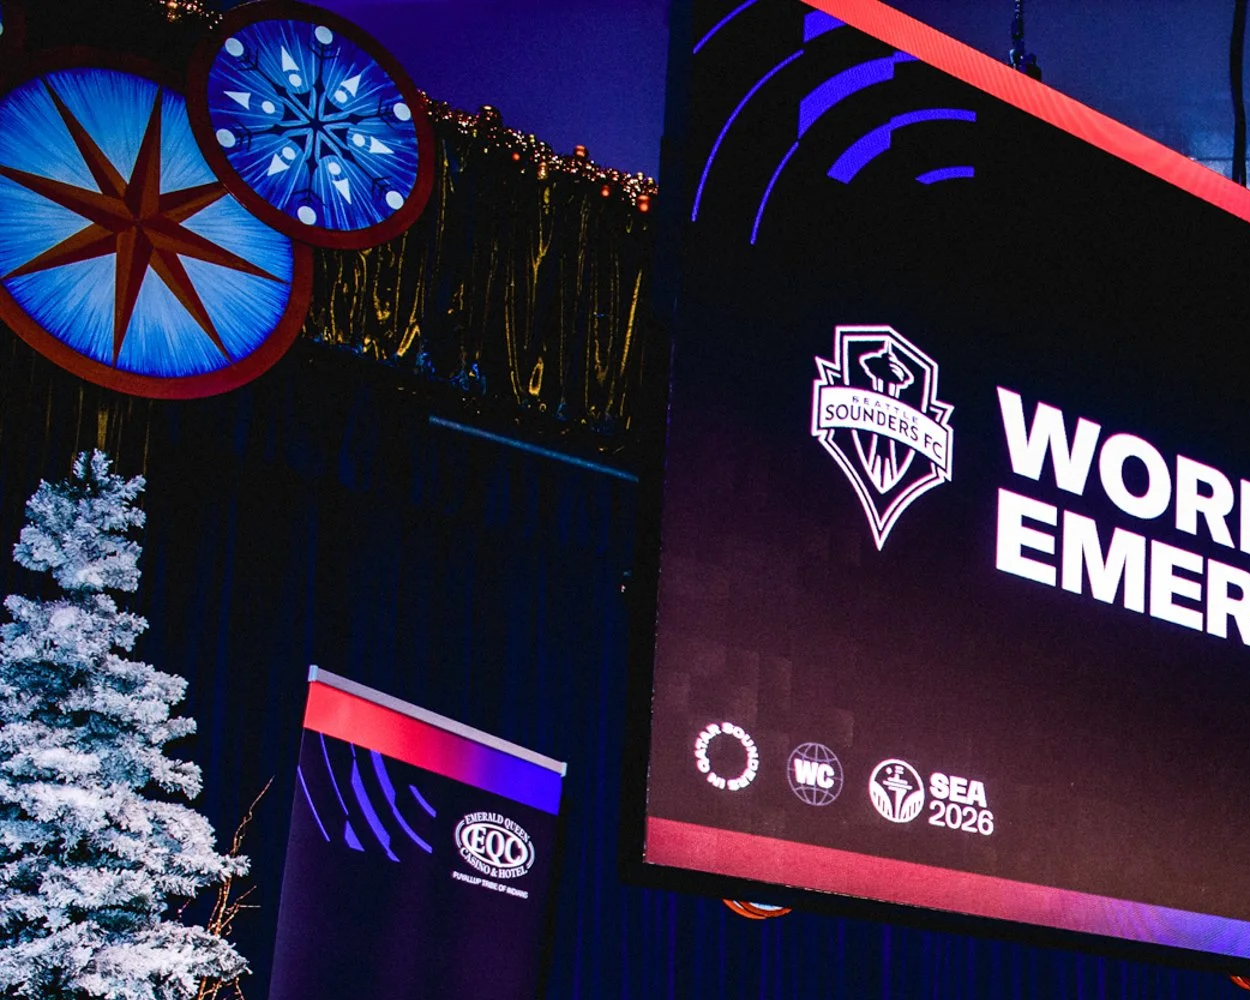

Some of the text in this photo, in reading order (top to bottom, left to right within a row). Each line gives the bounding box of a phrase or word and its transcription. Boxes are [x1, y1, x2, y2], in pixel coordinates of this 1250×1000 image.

[852, 395, 919, 425] SEATTLE
[825, 403, 943, 460] SOUNDERS FC
[794, 758, 835, 789] WC
[929, 772, 988, 808] SEA
[464, 812, 530, 843] EMERALD QUEEN
[928, 800, 994, 836] 2026
[470, 826, 522, 865] EQC
[460, 847, 528, 879] CASINO & HOTEL
